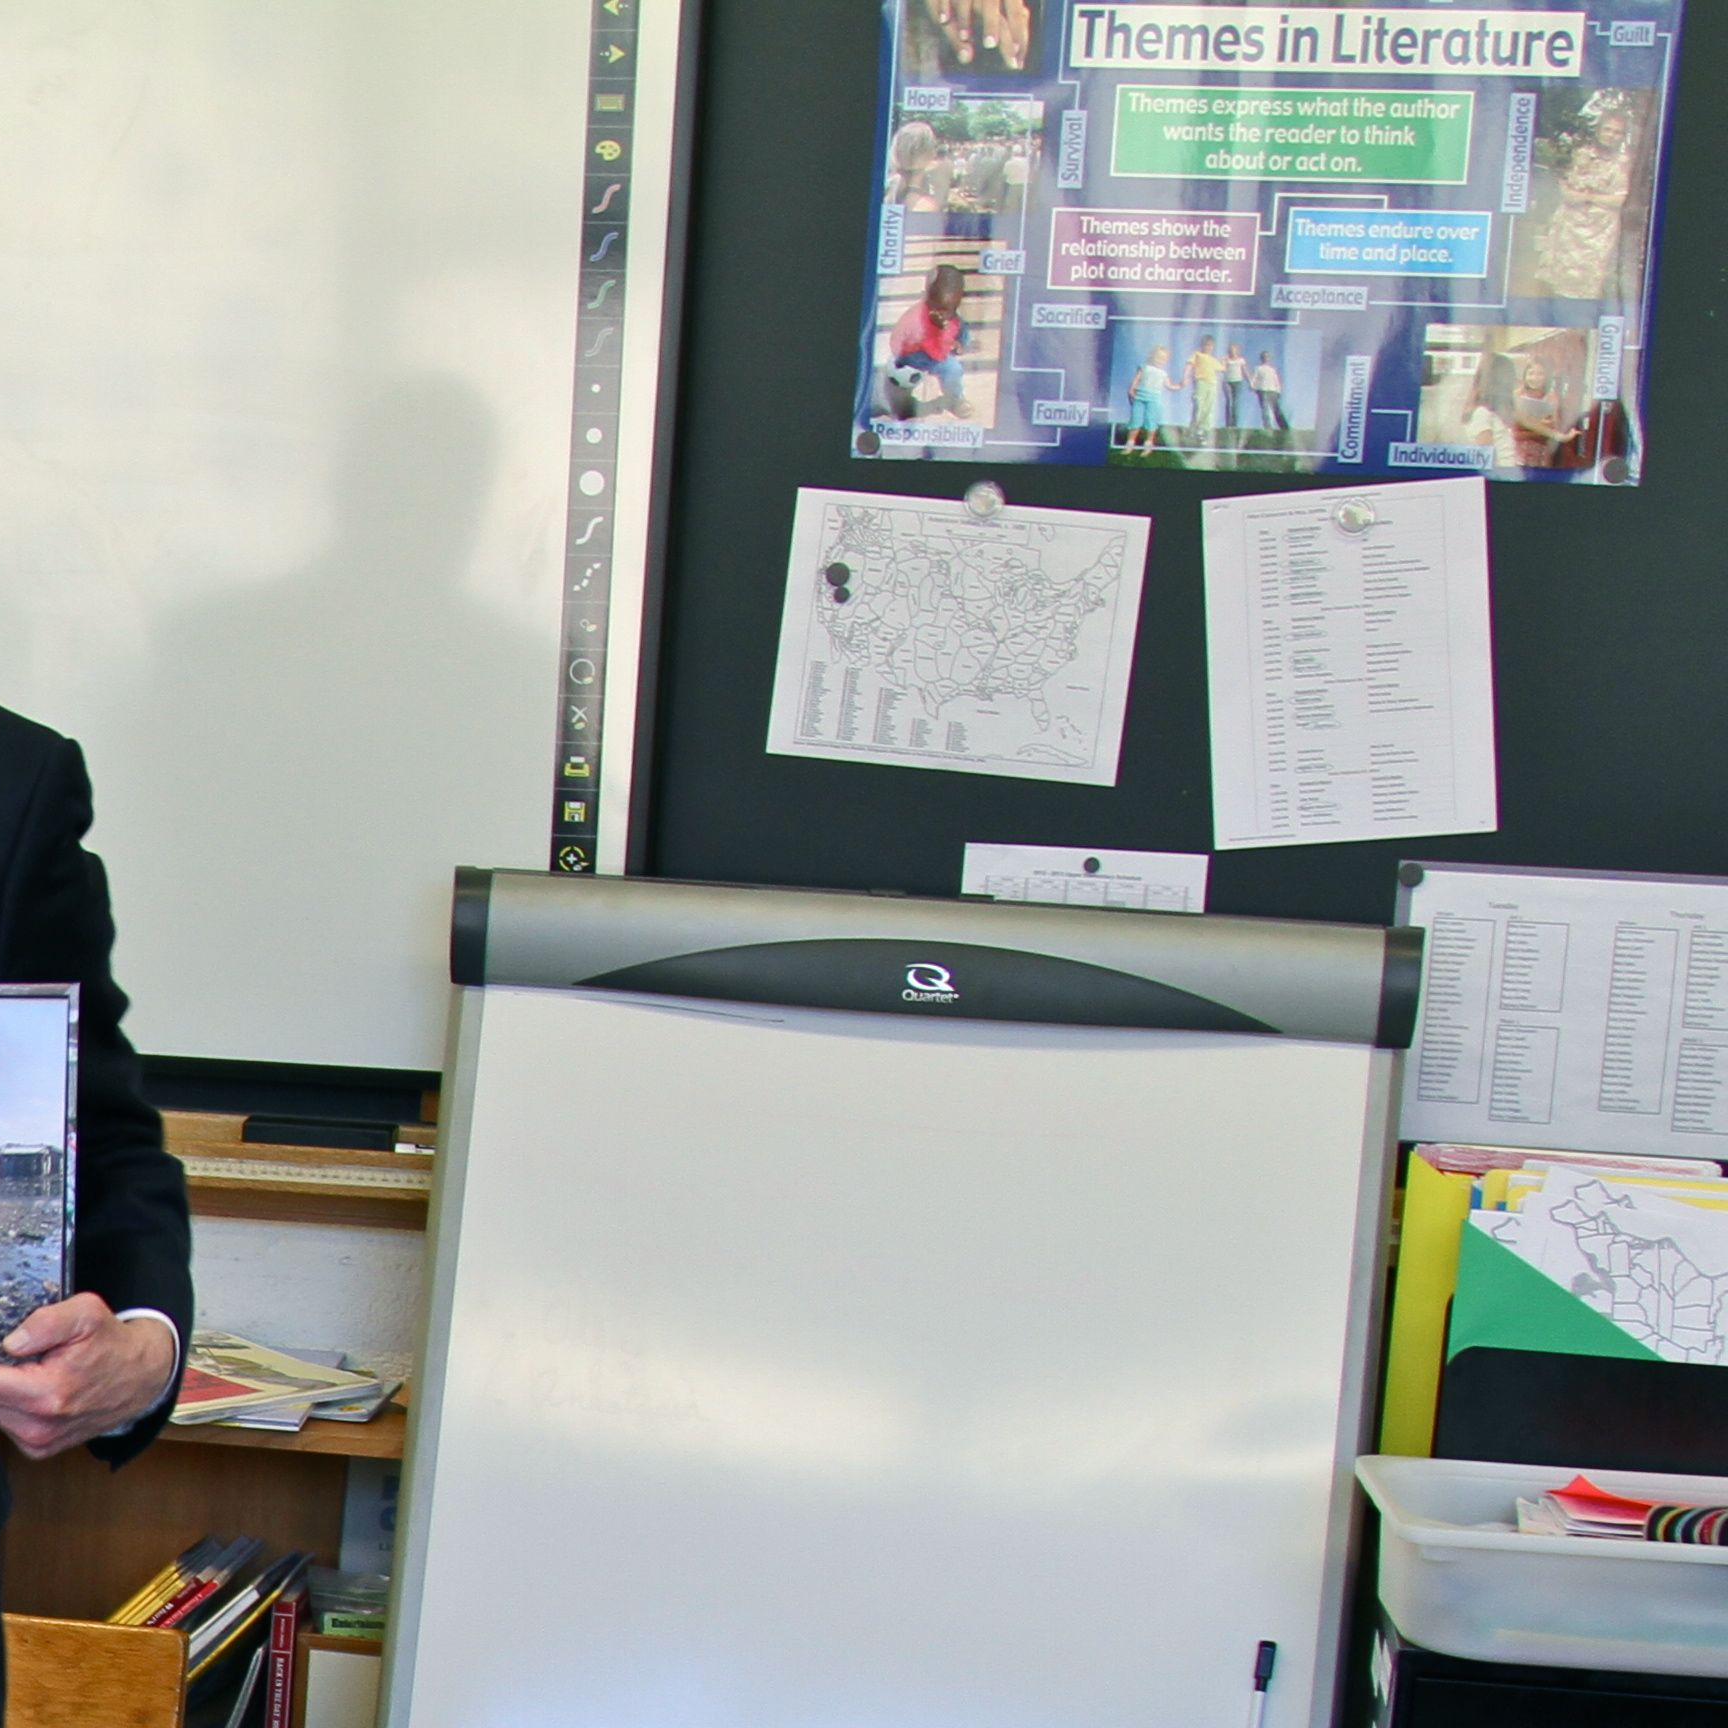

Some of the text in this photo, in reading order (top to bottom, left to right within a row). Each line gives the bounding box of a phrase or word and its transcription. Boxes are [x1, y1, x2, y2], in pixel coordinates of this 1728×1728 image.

[1078, 9, 1574, 67] Themes in Literature
[1614, 25, 1649, 41] Guilt
[907, 90, 948, 109] Hope
[1128, 92, 1460, 119] Themes express what the author
[1162, 122, 1415, 146] wants the reader to think
[1061, 116, 1082, 180] Survival
[1505, 97, 1531, 207] Independence
[1205, 151, 1362, 172] about or act on.
[1079, 216, 1231, 238] Themes show the
[1294, 218, 1479, 241] Themes endure over
[880, 208, 902, 269] Charity
[983, 252, 1021, 270] Grief
[1061, 239, 1245, 263] relationship between
[1319, 242, 1452, 264] time and place.
[1070, 261, 1232, 283] plot and character.
[1274, 287, 1363, 307] Acceptance
[1036, 307, 1101, 324] Sacrifice
[1596, 324, 1620, 394] Gratitude
[1036, 402, 1087, 423] Family
[1341, 361, 1364, 459] Commitment
[876, 423, 980, 445] Responsibility
[1393, 447, 1490, 466] Individuality
[902, 989, 953, 1004] Quartet
[275, 1657, 285, 1678] BACK
[275, 1679, 283, 1687] IN
[274, 1688, 283, 1702] THE
